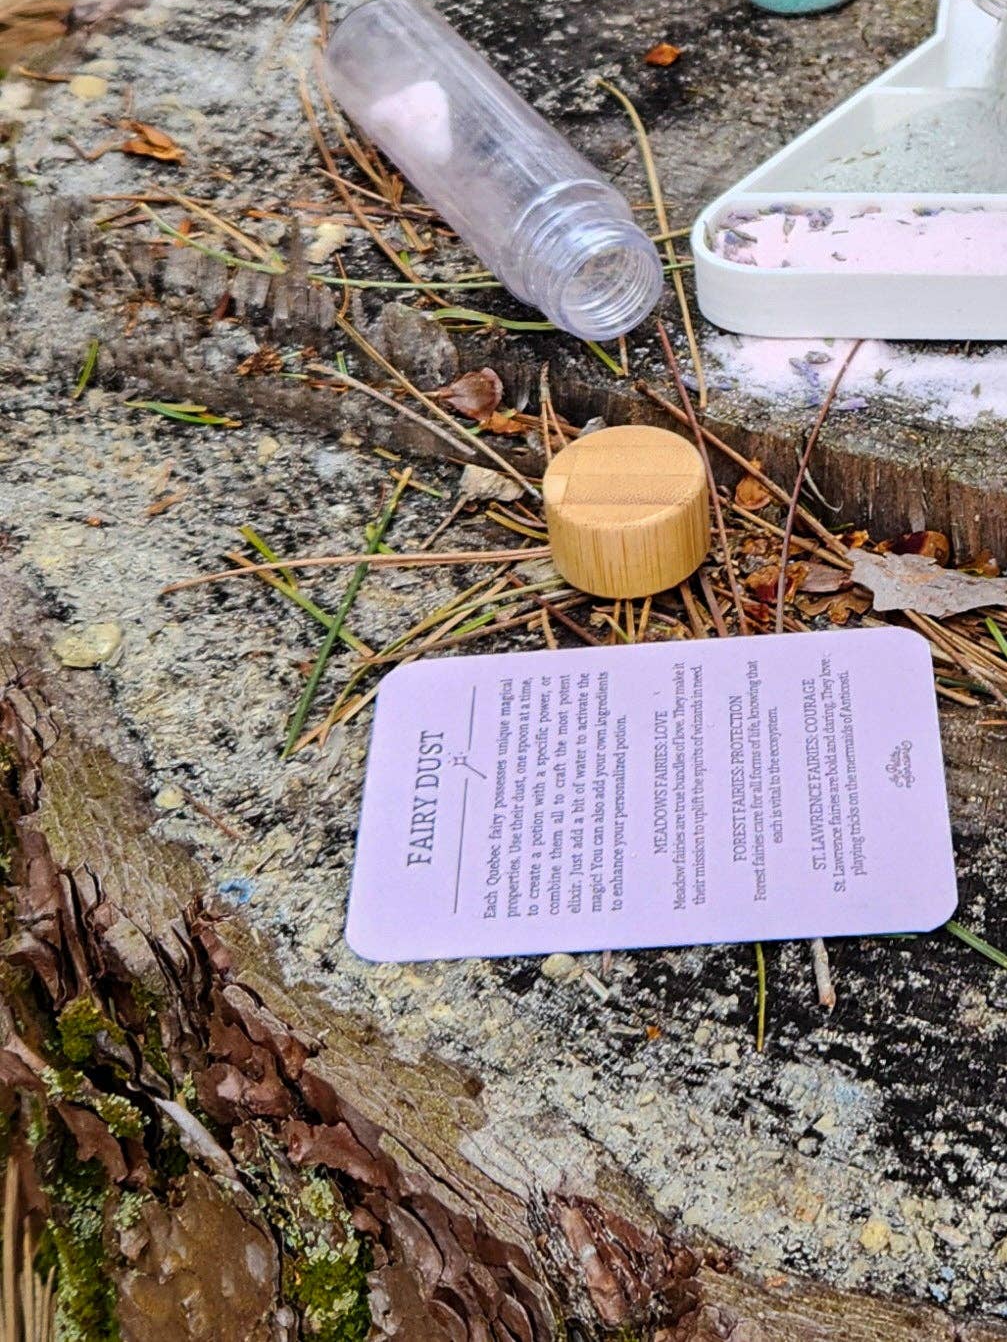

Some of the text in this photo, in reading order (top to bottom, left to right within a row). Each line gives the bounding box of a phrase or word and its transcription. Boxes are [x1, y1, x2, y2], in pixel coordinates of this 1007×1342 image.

[671, 662, 685, 670] it
[745, 660, 758, 680] that
[817, 659, 831, 678] love
[519, 677, 532, 702] time,
[540, 676, 551, 687] or
[576, 673, 589, 689] the
[671, 671, 685, 695] make
[819, 679, 835, 701] They
[690, 689, 702, 699] in
[746, 681, 762, 720] knowing
[801, 679, 817, 733] COURAGE
[518, 712, 530, 721] at
[539, 691, 553, 723] power,
[575, 693, 588, 731] activate
[672, 696, 688, 719] They
[690, 700, 703, 736] wizards
[838, 714, 853, 724] of
[654, 711, 668, 740] LOVE
[728, 696, 744, 765] PROTECTION
[517, 725, 531, 754] spoon
[533, 728, 551, 766] specific
[575, 735, 587, 745] to
[671, 742, 685, 752] of
[690, 736, 703, 748] of
[747, 738, 760, 750] of
[822, 735, 836, 754] and
[840, 725, 855, 773] mermaids
[516, 755, 527, 774] one
[574, 750, 586, 779] water
[671, 753, 685, 791] bundles
[691, 749, 707, 777] spirits
[748, 751, 762, 780] forms
[766, 757, 780, 774] the
[823, 753, 838, 777] bold
[511, 777, 526, 802] dust,
[571, 783, 585, 794] of
[588, 672, 611, 912] magic! You can also add your own ingredients
[691, 778, 704, 794] the
[748, 781, 762, 793] all
[769, 776, 780, 786] to
[828, 777, 839, 793] are
[843, 773, 857, 792] the
[407, 731, 443, 867] FAIRY DUST
[482, 679, 515, 919] Each Quebec fairy possesses unique magical
[531, 783, 545, 806] with
[546, 674, 573, 915] combine them all to craft the most potent
[570, 798, 585, 813] bit
[674, 793, 685, 813] true
[749, 795, 763, 809] for
[768, 786, 781, 810] vital
[847, 793, 859, 806] on
[509, 805, 524, 831] their
[609, 715, 629, 911] to enhance your personalized potion.
[653, 789, 667, 854] MEADOWS
[690, 796, 707, 823] uplift
[772, 810, 782, 818] is
[808, 783, 825, 852] LAWRENCE
[826, 794, 841, 826] fairies
[846, 807, 861, 836] tricks
[529, 811, 547, 847] potion
[675, 815, 685, 831] are
[693, 824, 704, 837] to
[753, 811, 764, 833] care
[769, 820, 783, 844] each
[508, 834, 522, 854] Use
[569, 829, 583, 849] add
[671, 832, 685, 864] fairies
[731, 814, 747, 862] FOREST
[751, 834, 765, 866] fairies
[691, 838, 705, 878] mission
[830, 828, 844, 877] Lawrence
[848, 837, 867, 876] playing
[569, 854, 584, 876] Just
[506, 857, 523, 918] properties.
[528, 864, 541, 899] create
[672, 866, 686, 910] Meadow
[691, 879, 705, 905] their
[753, 868, 766, 901] Forest
[566, 881, 582, 914] elixir.
[526, 905, 539, 917] to
